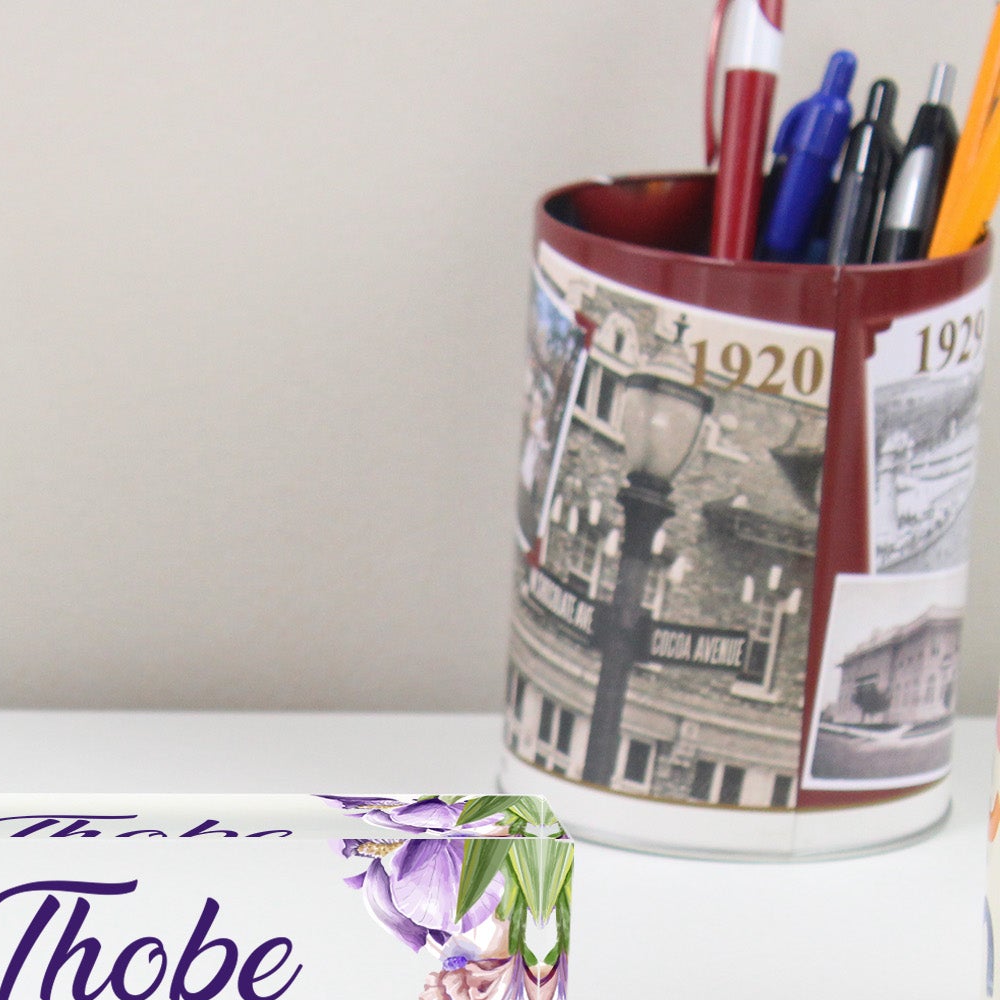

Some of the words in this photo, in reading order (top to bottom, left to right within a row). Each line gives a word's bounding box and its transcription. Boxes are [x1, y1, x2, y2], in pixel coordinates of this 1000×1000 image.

[690, 339, 824, 396] 1920
[916, 308, 985, 375] 1929
[651, 627, 693, 661] COCOA
[692, 635, 747, 668] AVENUE
